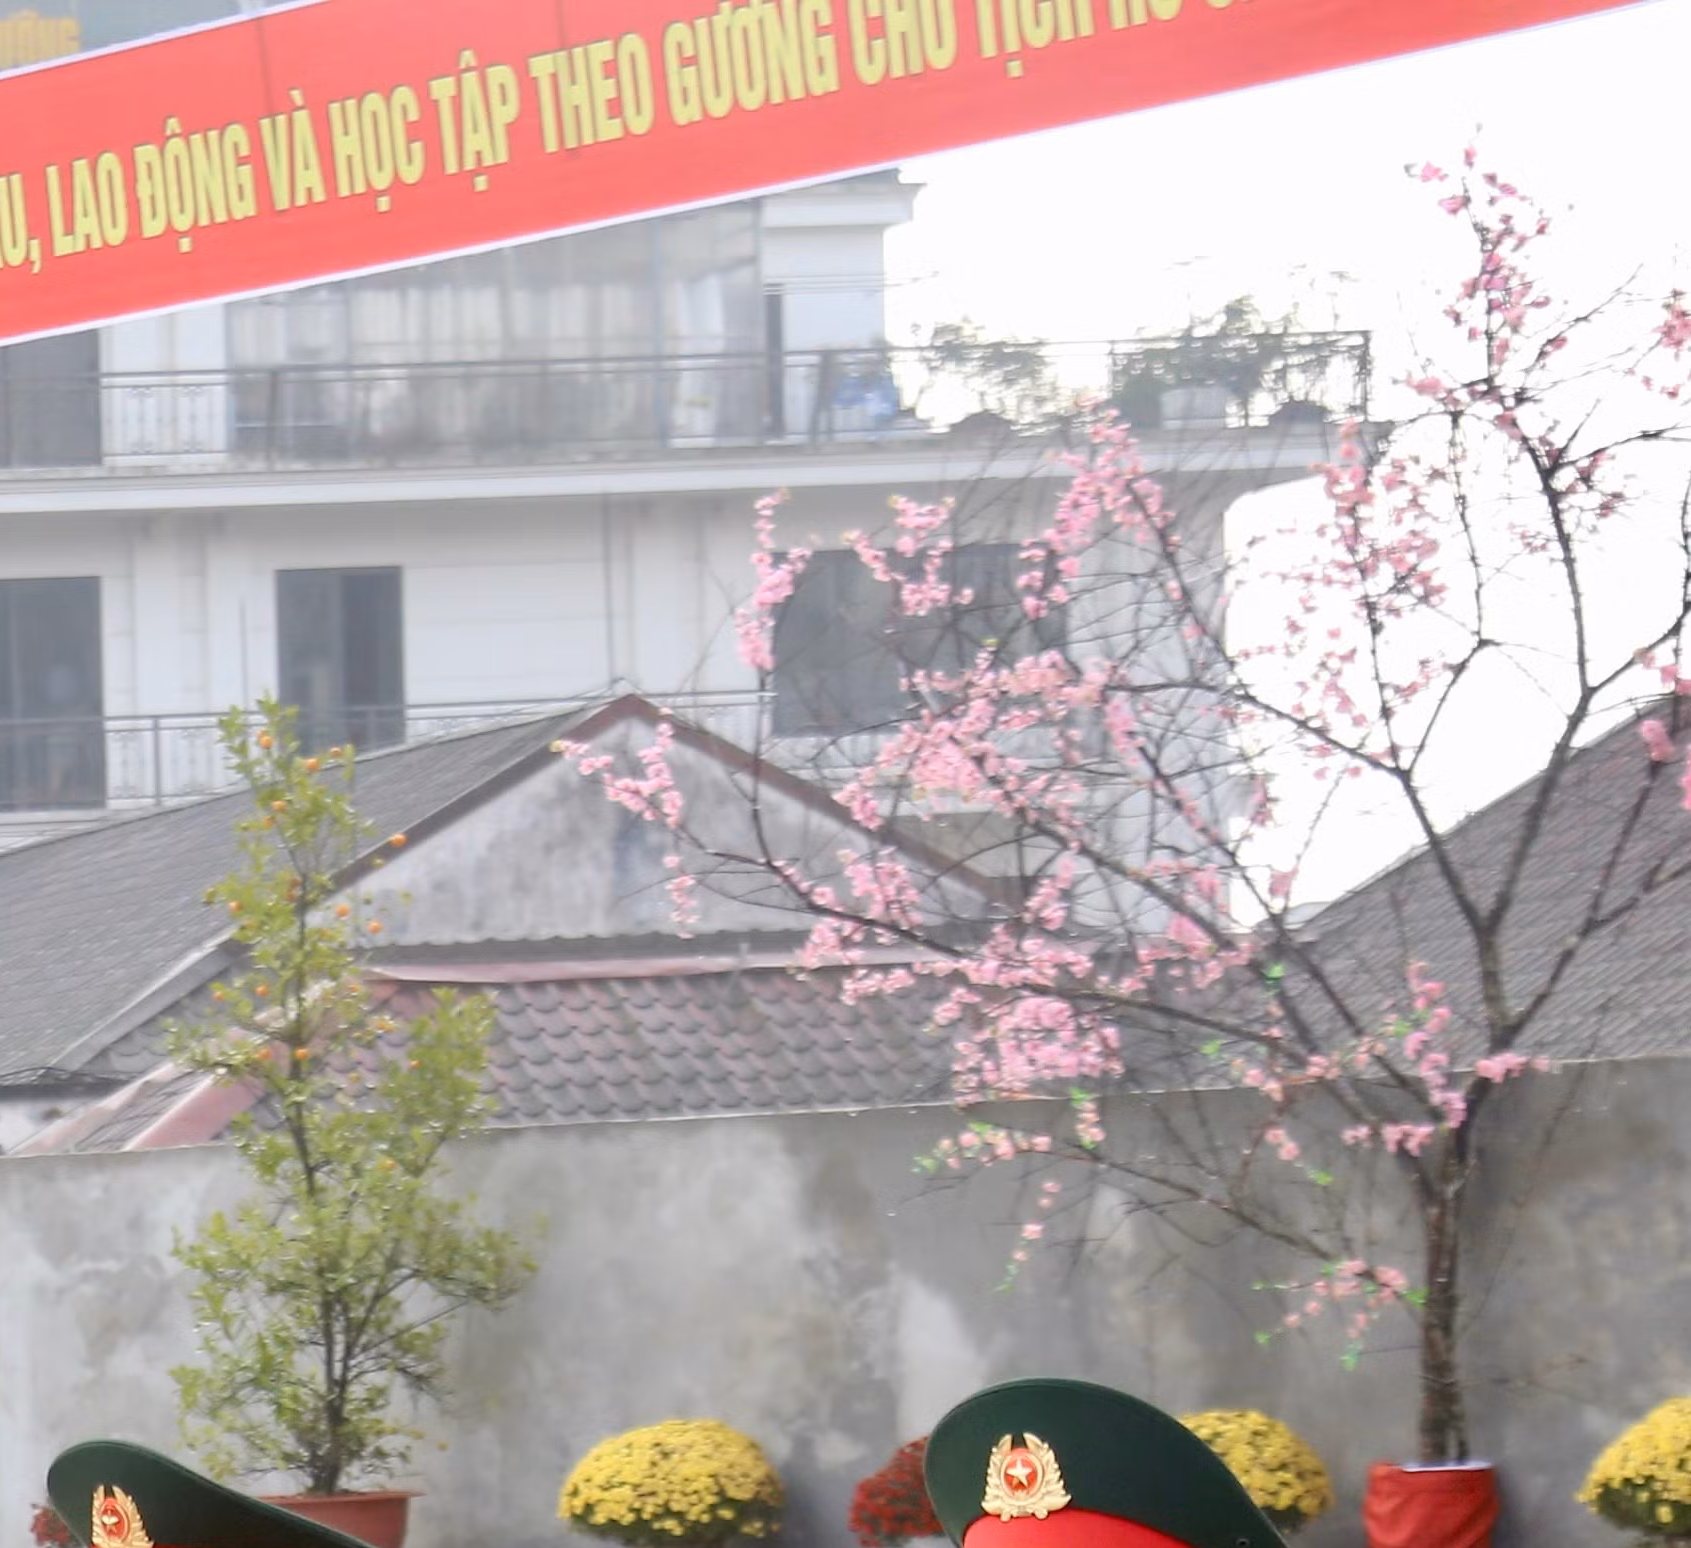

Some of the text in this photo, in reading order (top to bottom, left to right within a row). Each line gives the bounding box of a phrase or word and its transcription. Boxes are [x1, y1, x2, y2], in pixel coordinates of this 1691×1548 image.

[44, 150, 130, 258] LAO
[132, 115, 258, 254] ĐỘNG
[258, 87, 327, 212] VÀ
[327, 84, 425, 213] HỌC
[428, 48, 520, 193] TẬP
[527, 32, 656, 155] THEO
